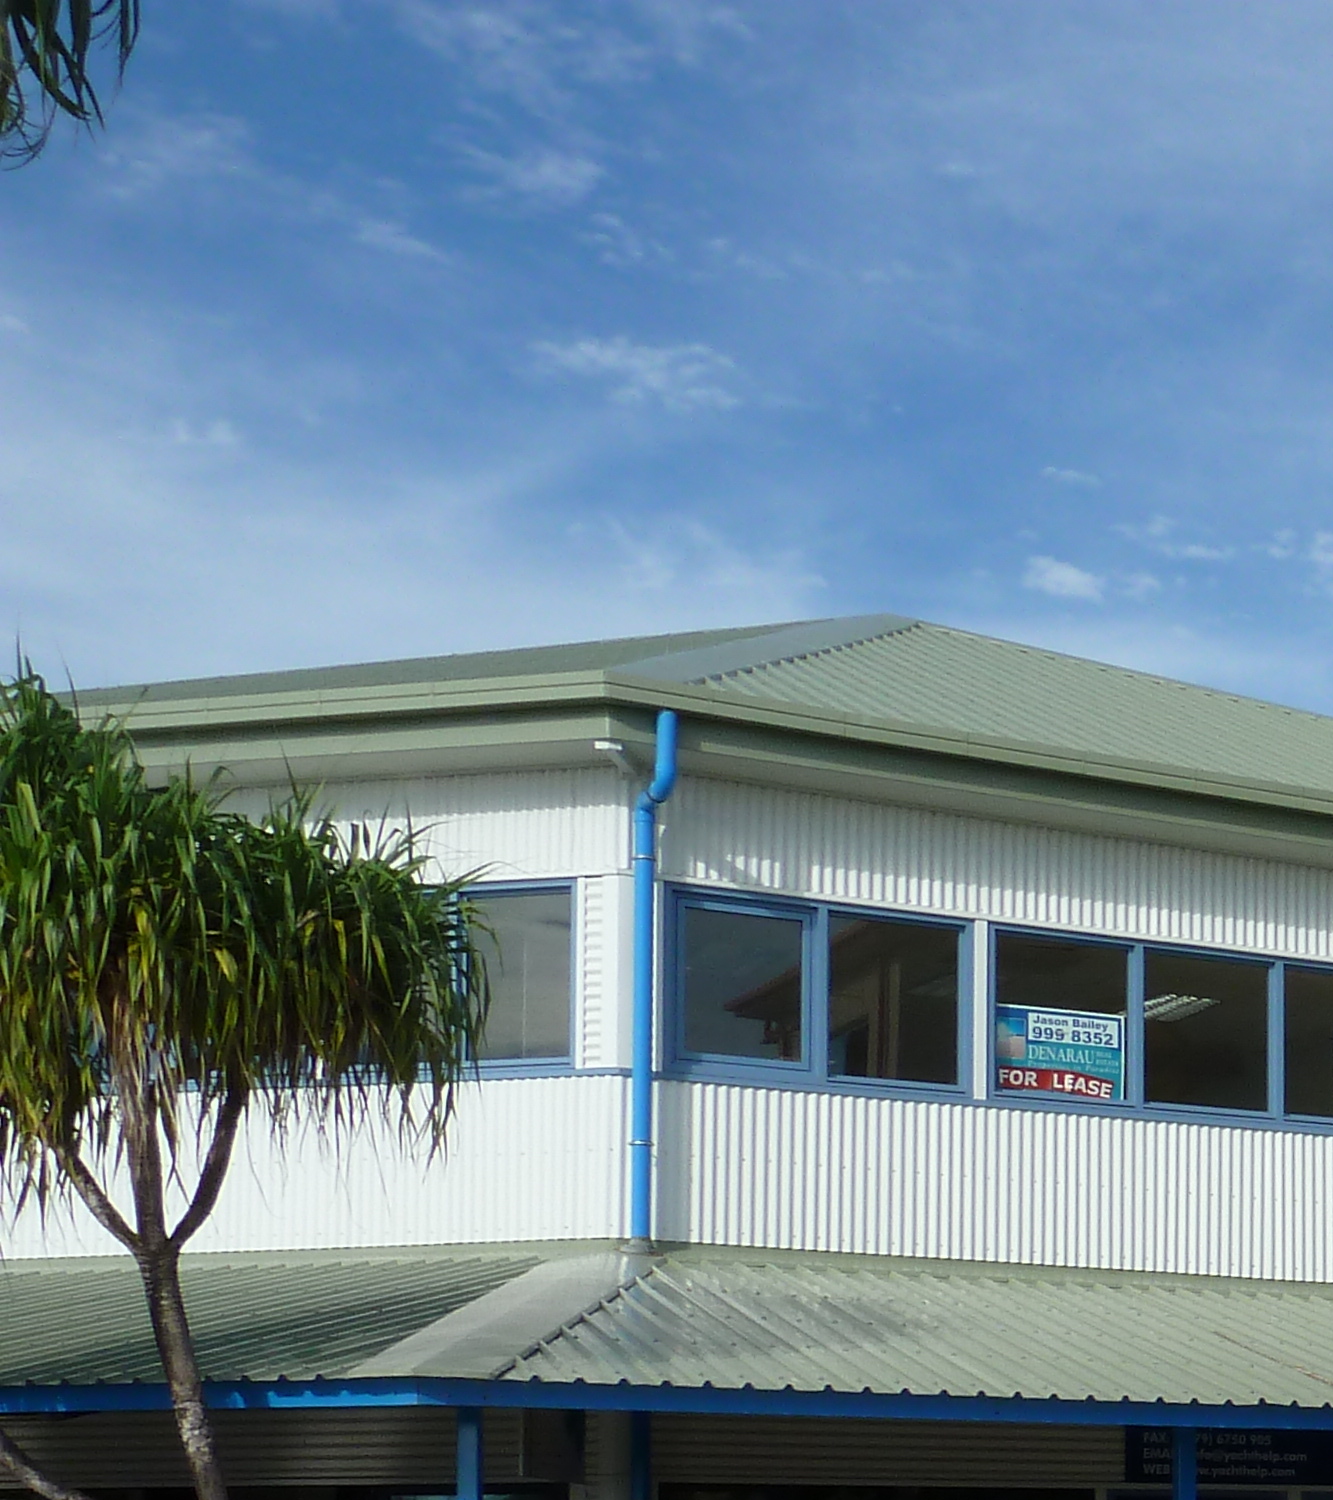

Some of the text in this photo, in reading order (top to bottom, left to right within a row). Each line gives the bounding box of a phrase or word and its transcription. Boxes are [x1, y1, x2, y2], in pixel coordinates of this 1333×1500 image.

[1032, 1014, 1109, 1033] Jason Bailey
[1032, 1026, 1115, 1046] 999 8352
[1028, 1044, 1095, 1064] DENARAU
[999, 1068, 1113, 1098] FOR LEASE
